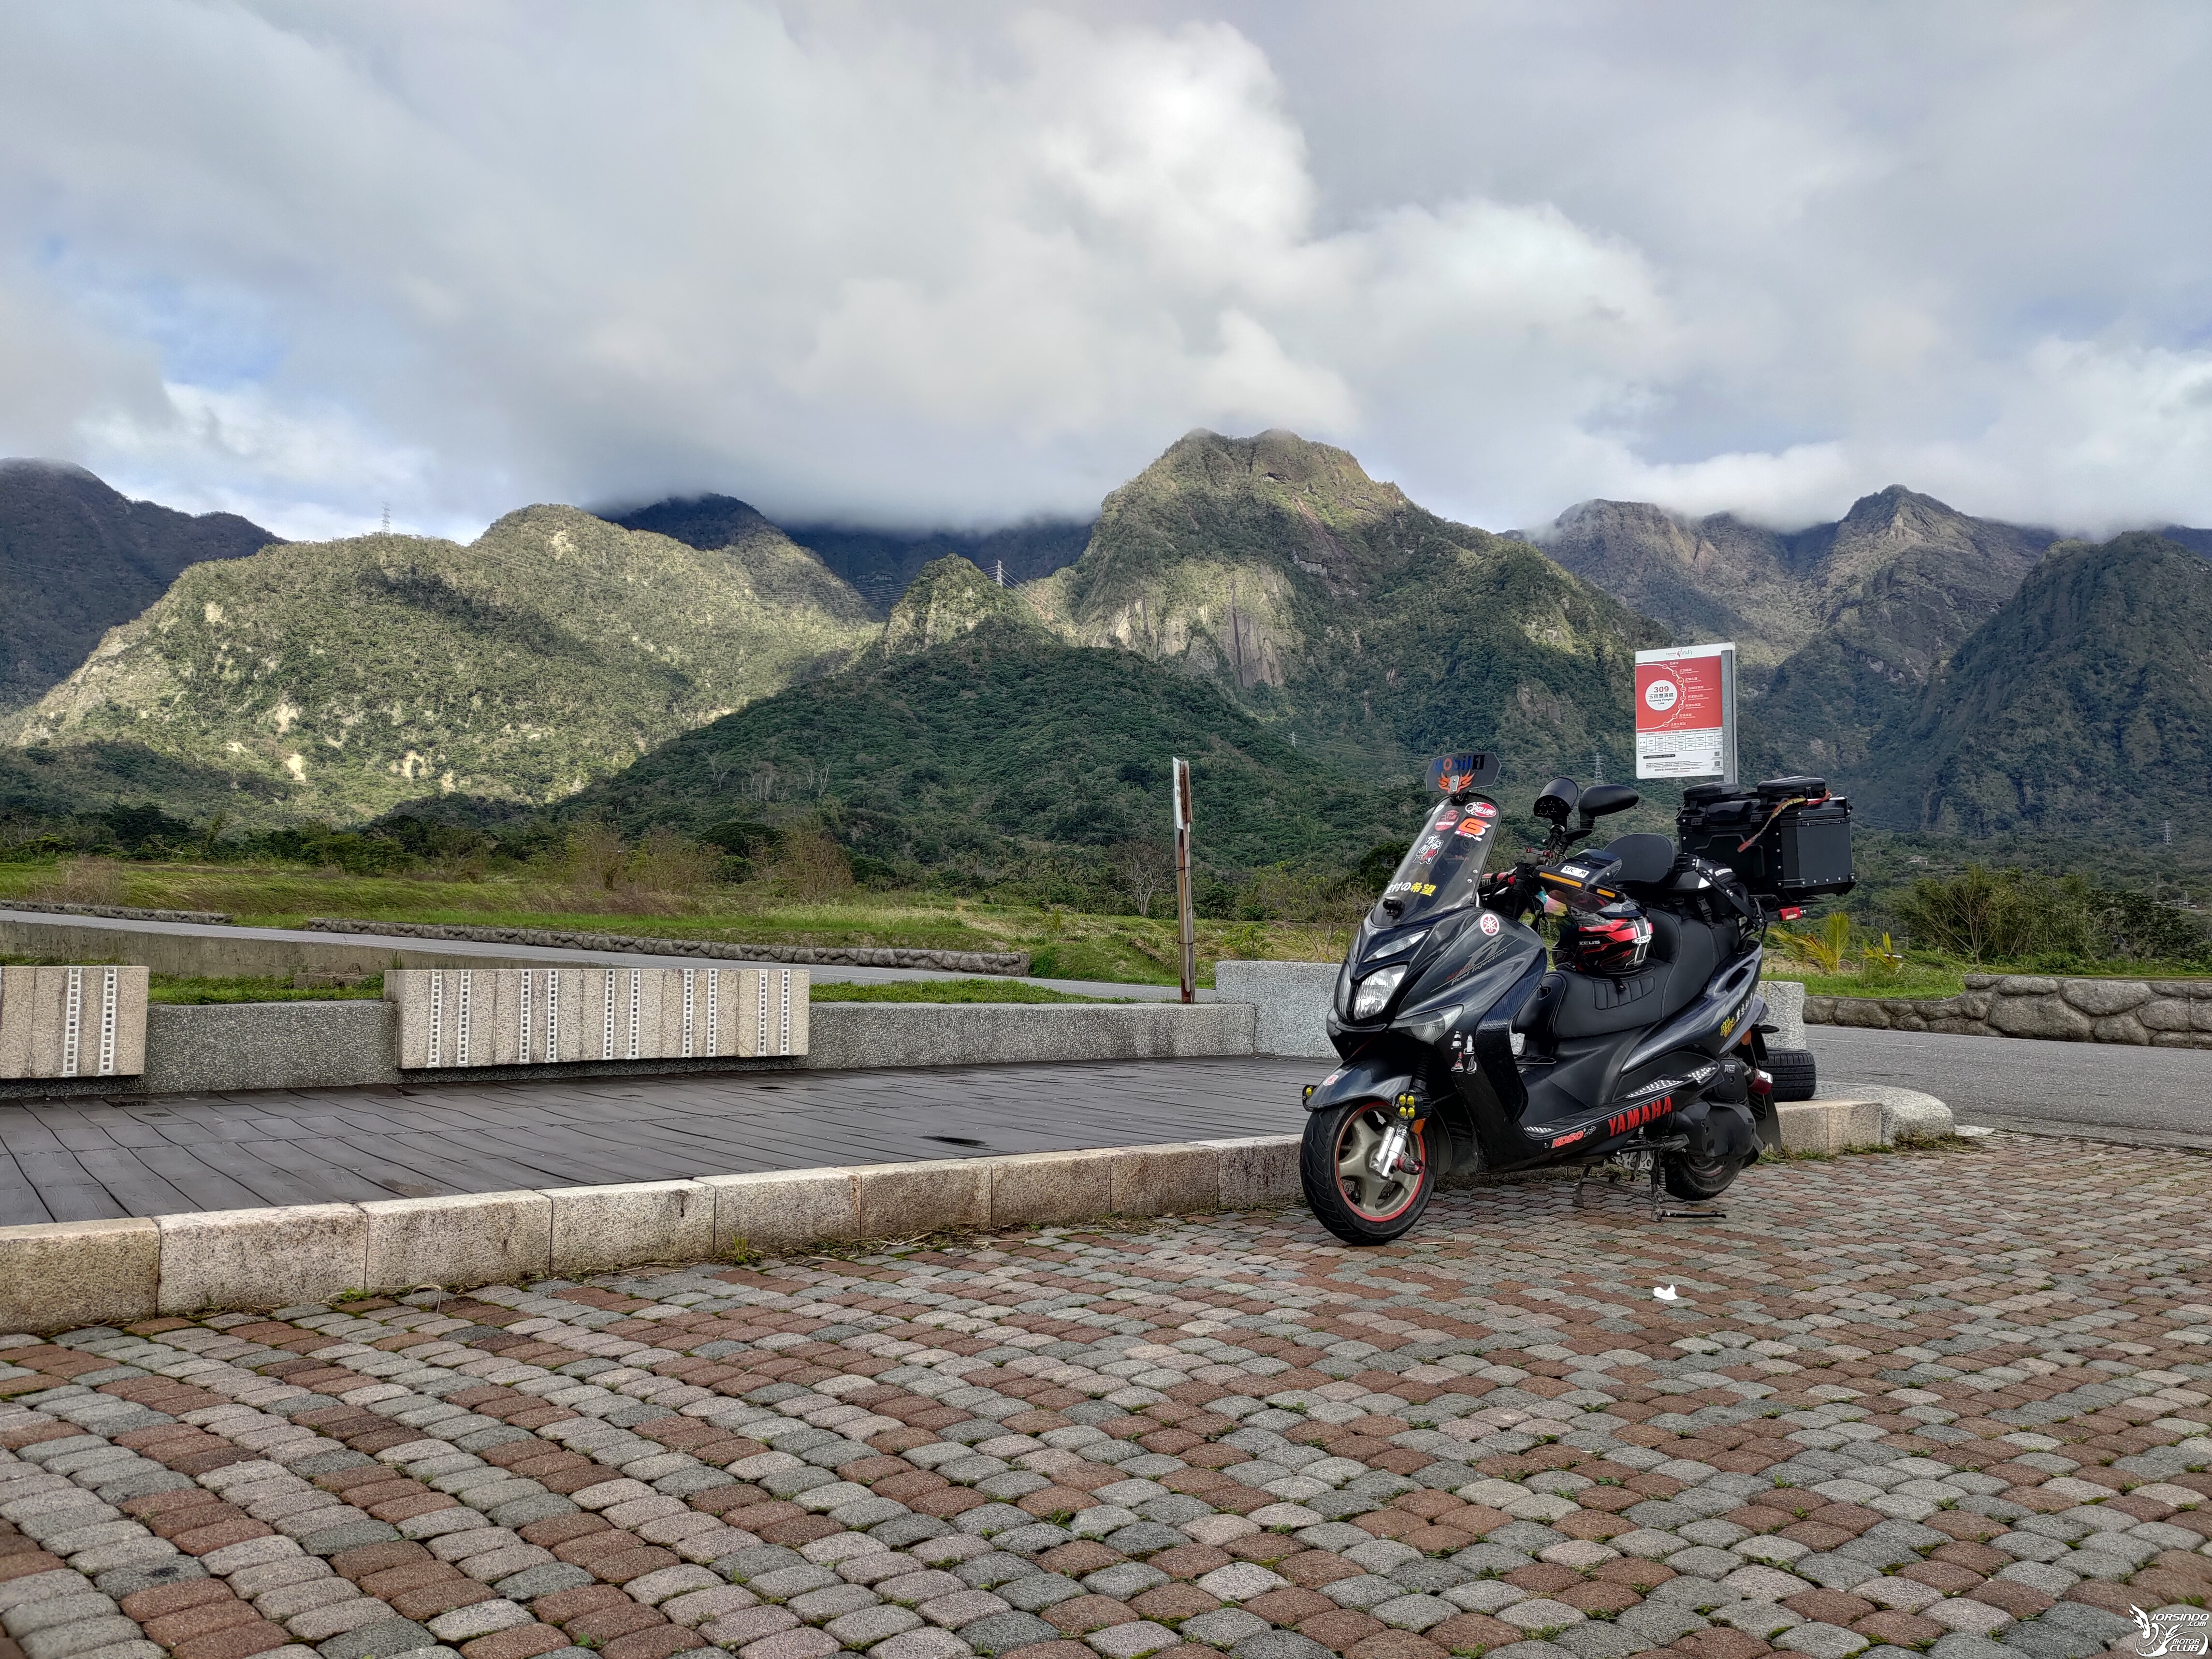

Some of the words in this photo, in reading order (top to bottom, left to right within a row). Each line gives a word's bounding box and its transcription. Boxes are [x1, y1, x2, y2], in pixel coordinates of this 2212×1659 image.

[1451, 971, 1470, 986] Fuel
[1471, 948, 1508, 973] Injection
[1608, 1095, 1673, 1136] YAMAHA
[1551, 1130, 1585, 1149] KOSO
